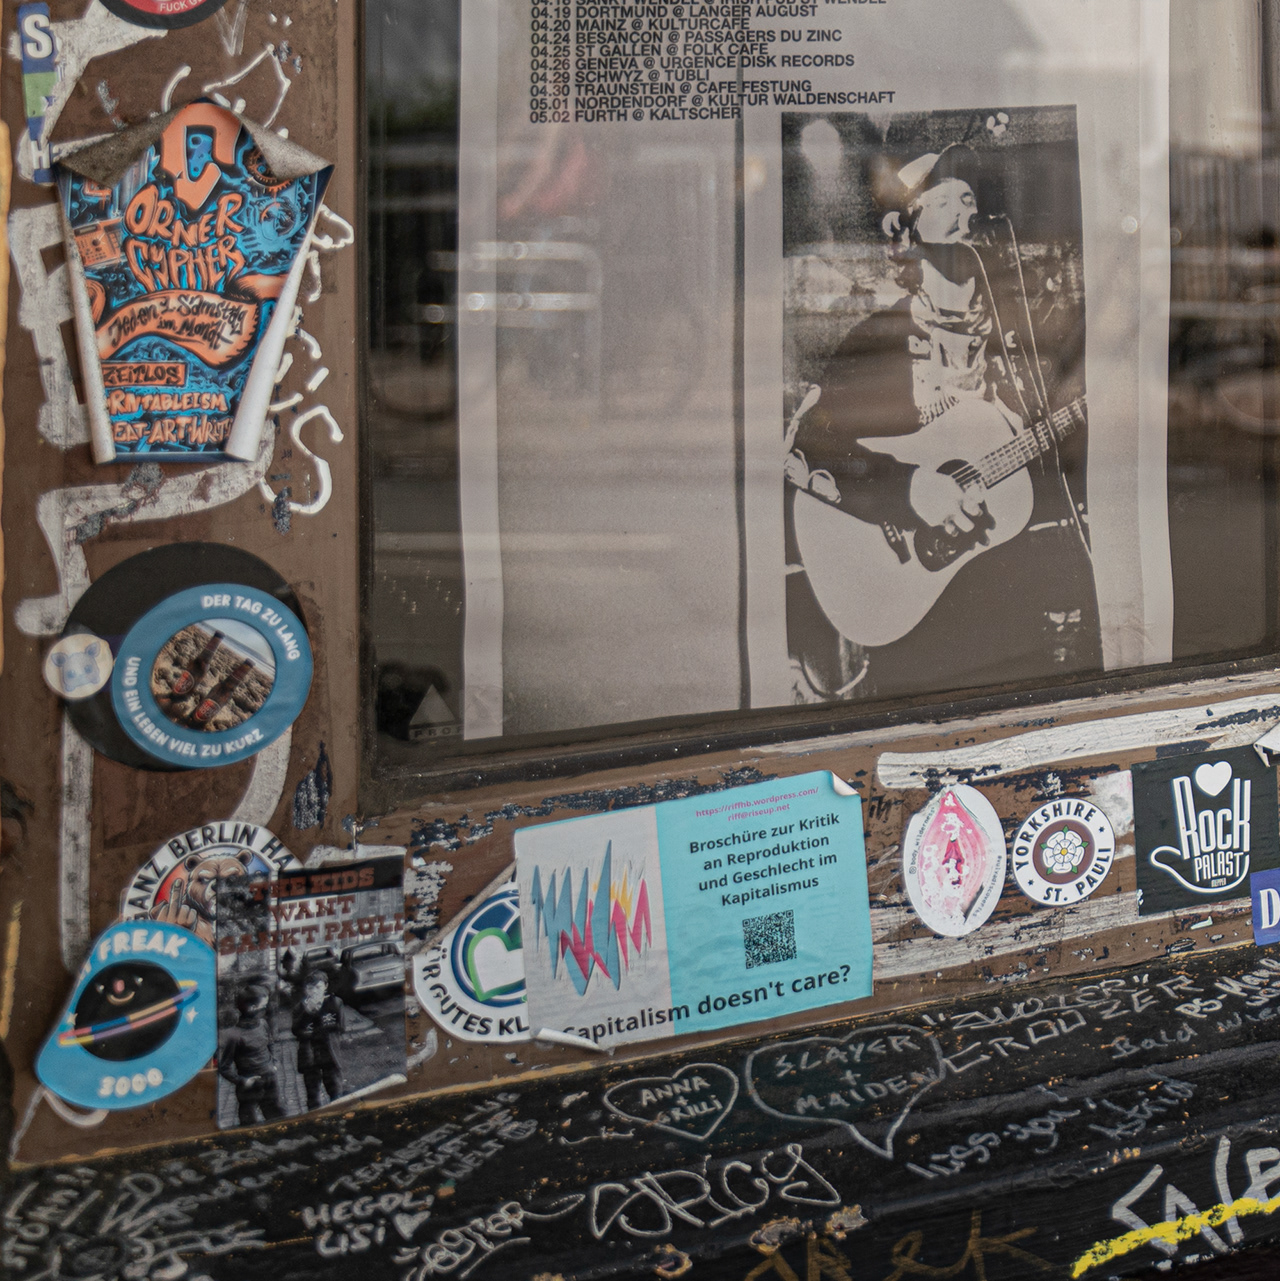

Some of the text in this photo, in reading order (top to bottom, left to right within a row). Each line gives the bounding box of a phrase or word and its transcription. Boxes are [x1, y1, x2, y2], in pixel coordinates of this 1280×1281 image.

[159, 0, 189, 13] FUCK
[530, 80, 812, 97] 04.30 TRAUNSTEIN @ CAFE FESTUNG
[202, 594, 301, 661] DER TAG ZU LANG
[123, 656, 265, 758] UND EIN LEBEN VIEL ZU KURZ
[726, 803, 791, 823] riff@riseup.net
[167, 822, 260, 859] BERLIN
[688, 812, 841, 855] Broschüre zur Kritik
[1014, 800, 1099, 871] YORKSHIRE
[703, 833, 831, 871] an Reproduktion
[1193, 850, 1246, 882] PALAST
[312, 866, 376, 893] KIDS
[698, 851, 839, 893] und Geschlecht im
[1042, 846, 1113, 903] ST. PAULI
[270, 894, 357, 923] WANT
[720, 876, 820, 908] Kapitalismus
[99, 928, 188, 961] FREAK
[697, 980, 786, 1015] doesn't
[790, 963, 852, 994] care?
[98, 1067, 164, 1097] 3000
